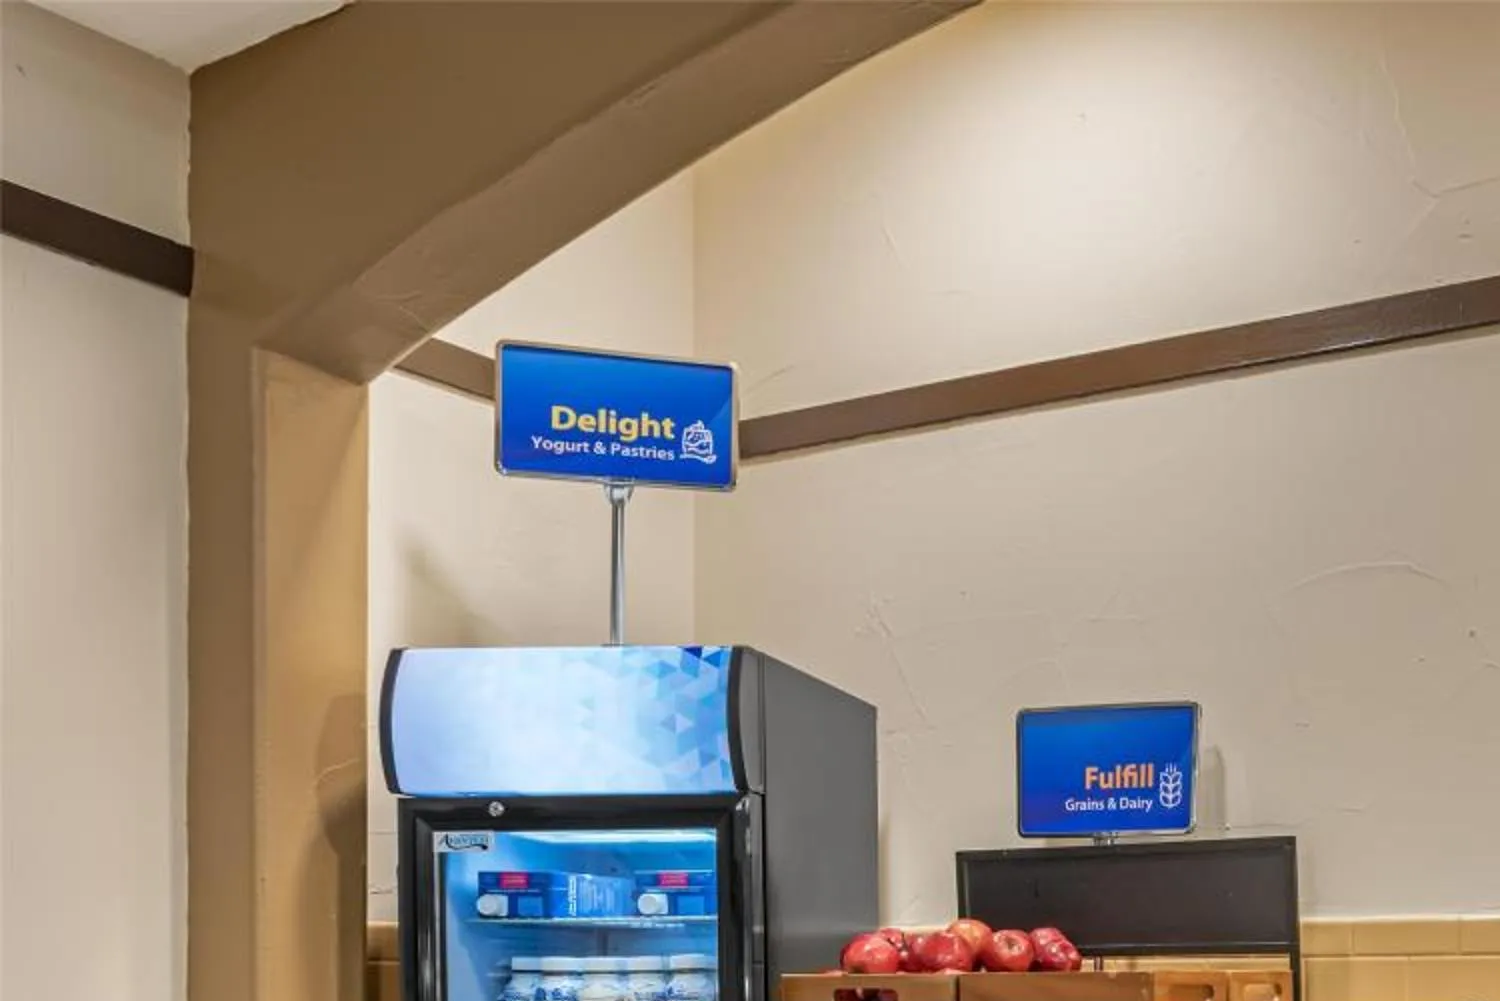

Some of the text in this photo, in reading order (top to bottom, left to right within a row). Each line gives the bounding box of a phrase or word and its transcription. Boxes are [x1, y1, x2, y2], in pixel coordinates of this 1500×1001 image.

[551, 405, 676, 442] Delight
[530, 435, 675, 461] Yogurt & Pastries
[1085, 763, 1155, 790] Fulfill
[1065, 796, 1154, 813] Grains & Dairy
